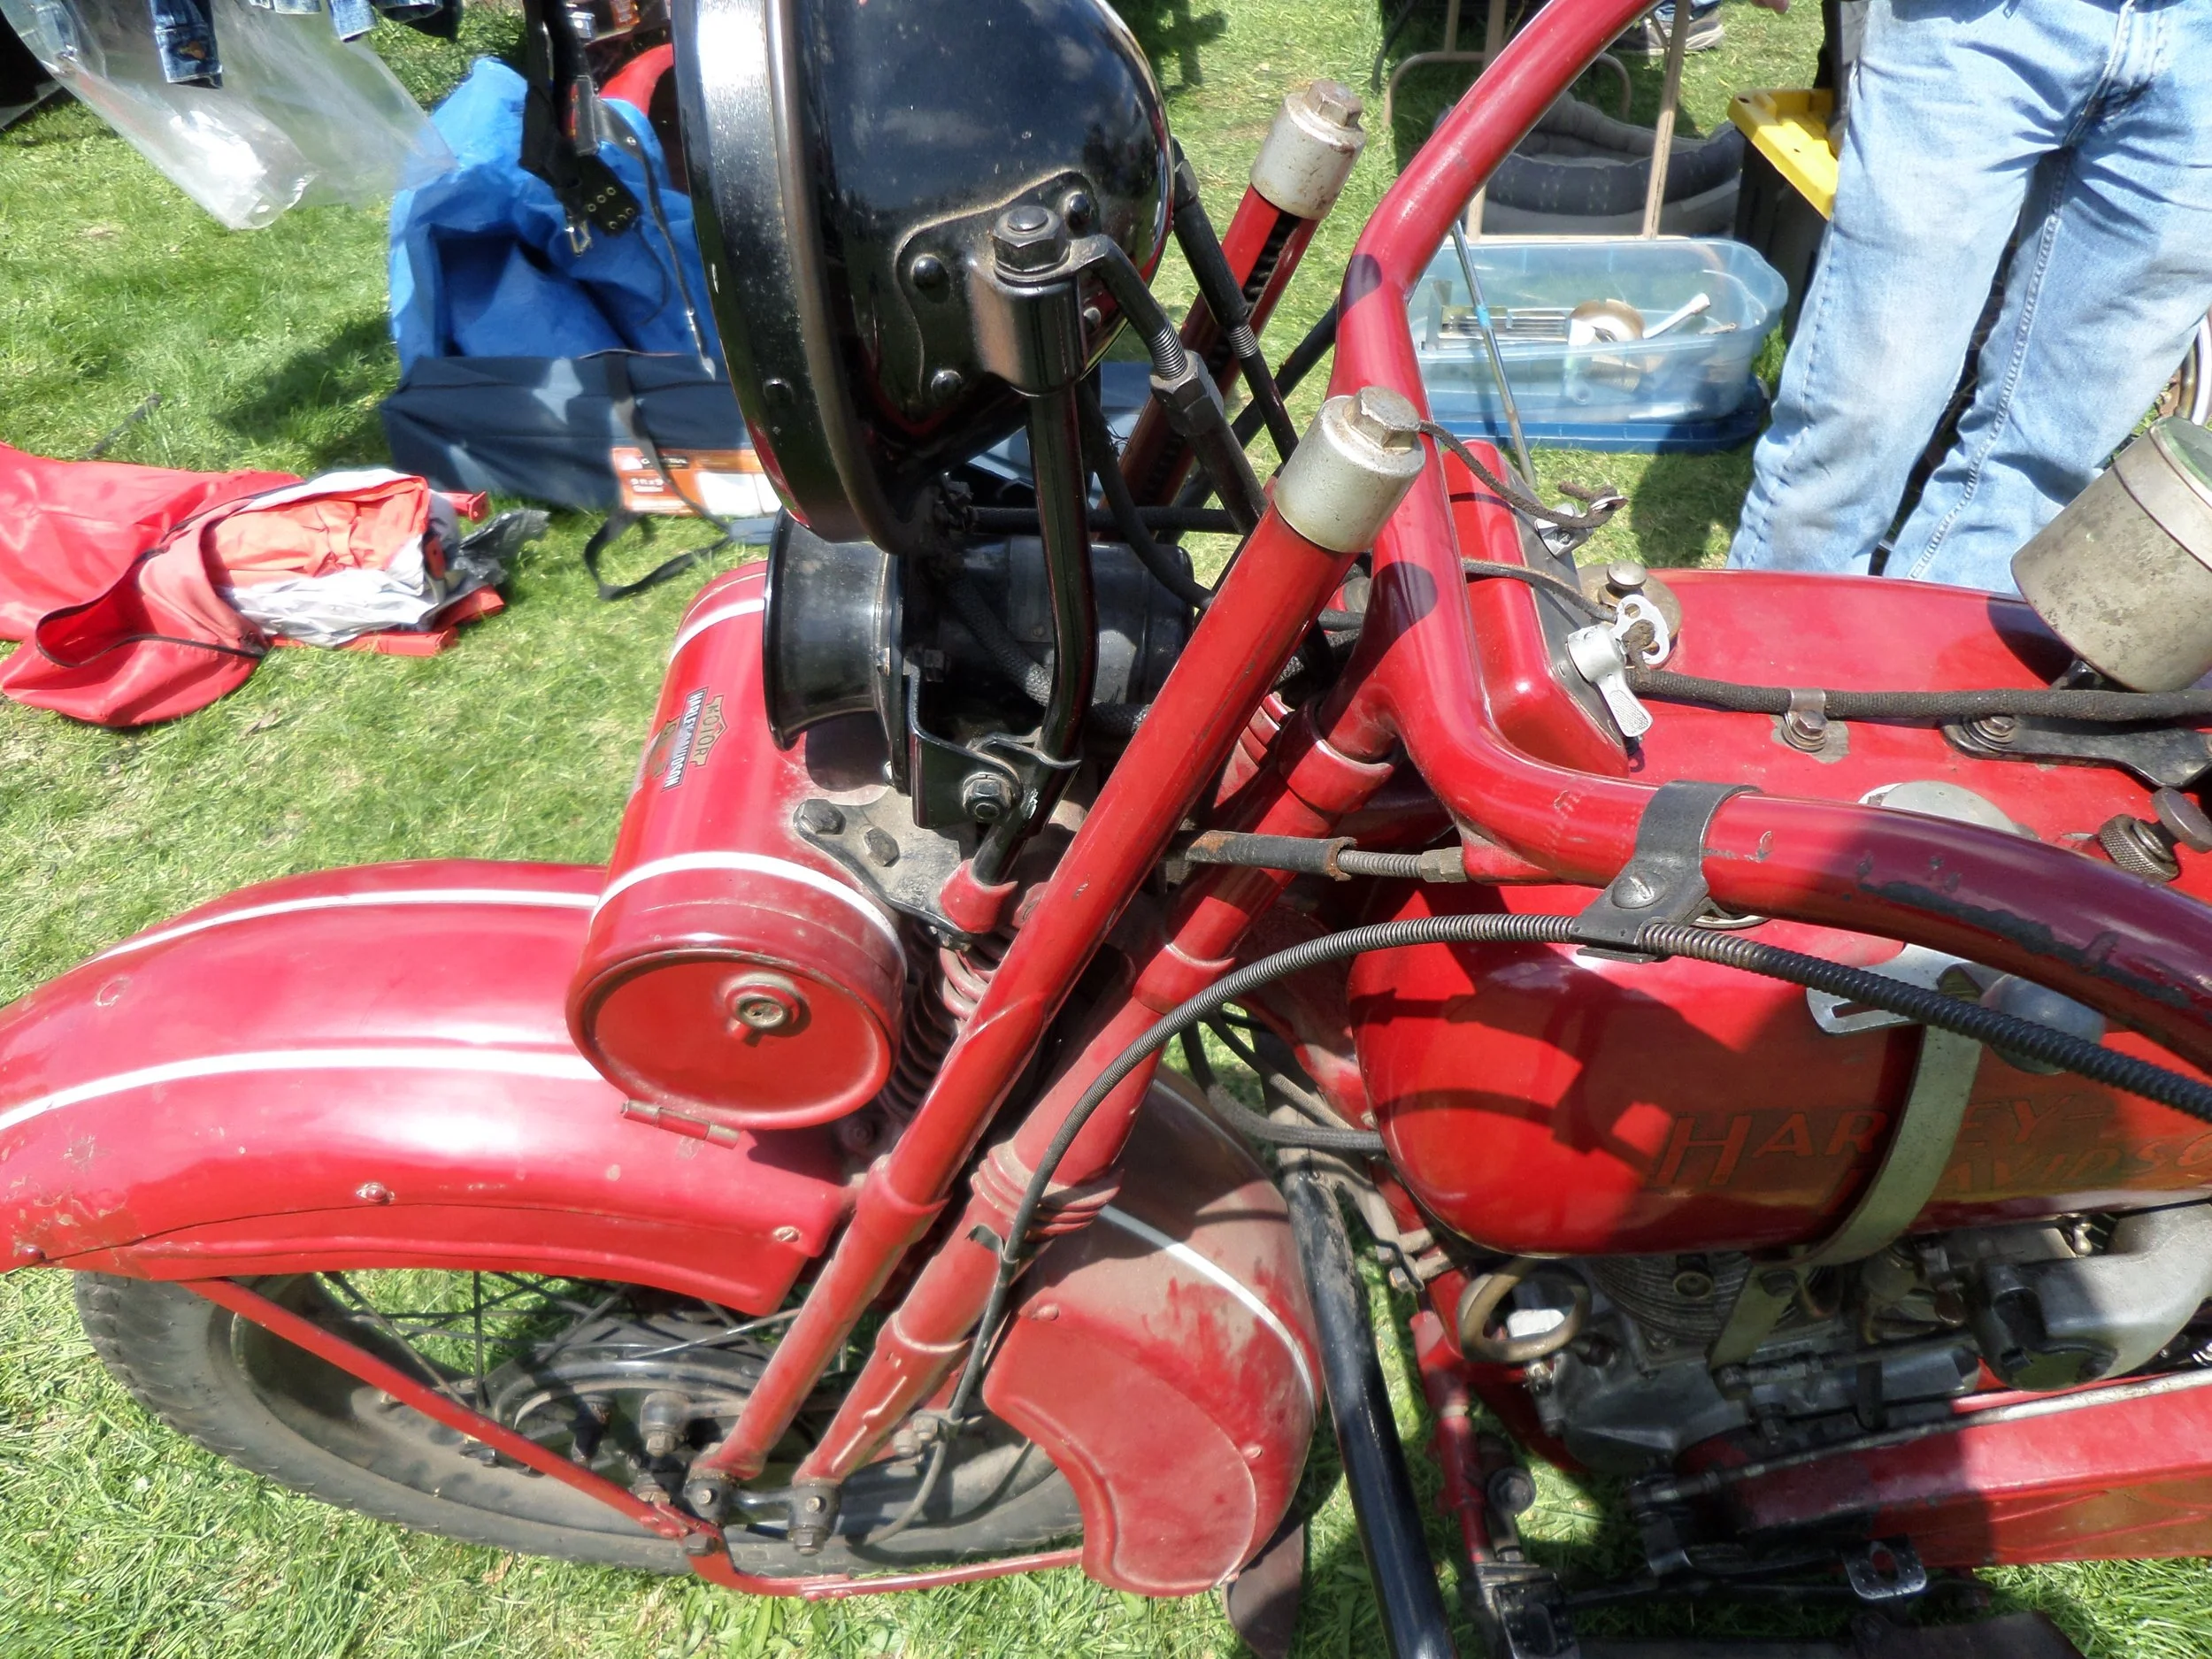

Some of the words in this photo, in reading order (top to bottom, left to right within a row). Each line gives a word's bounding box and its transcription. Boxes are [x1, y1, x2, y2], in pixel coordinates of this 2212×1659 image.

[664, 691, 704, 787] HARLEY-VIDSON
[694, 703, 724, 757] MOTOR
[1653, 1094, 2106, 1188] HAREY-
